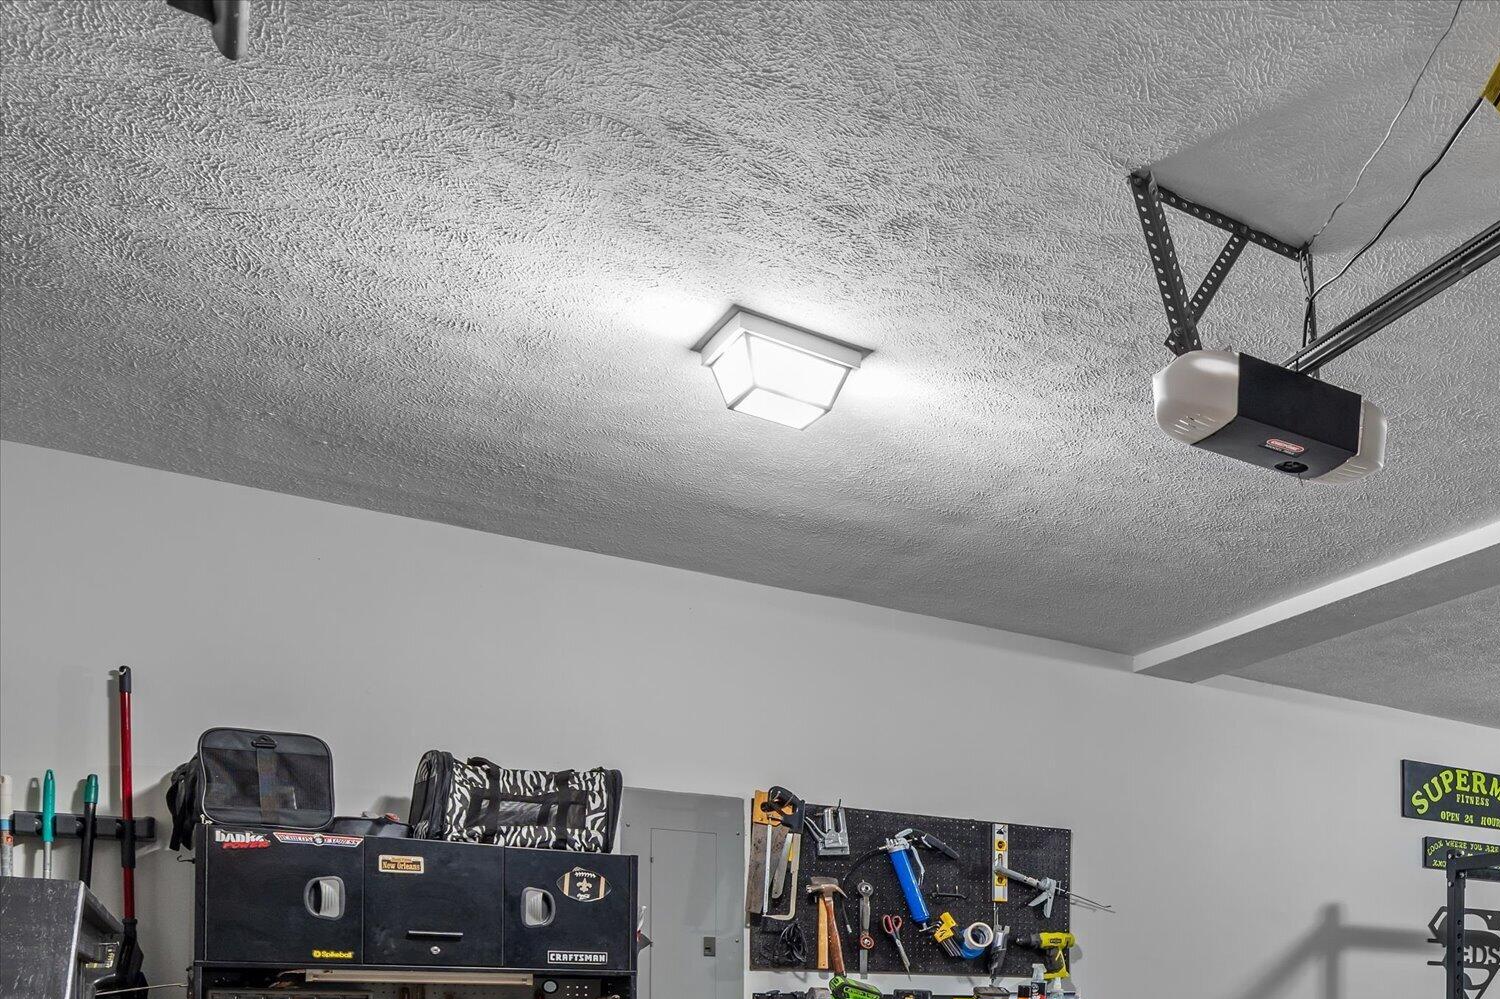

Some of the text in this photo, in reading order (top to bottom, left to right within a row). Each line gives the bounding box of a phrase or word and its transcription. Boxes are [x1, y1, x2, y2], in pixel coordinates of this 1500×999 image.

[1456, 793, 1490, 806] FITNESS
[1440, 810, 1460, 822] OPEN
[1464, 814, 1474, 824] 24
[382, 861, 421, 871] New Orleans
[321, 950, 353, 959] Spikeball
[549, 953, 606, 962] CRAFTSMAN
